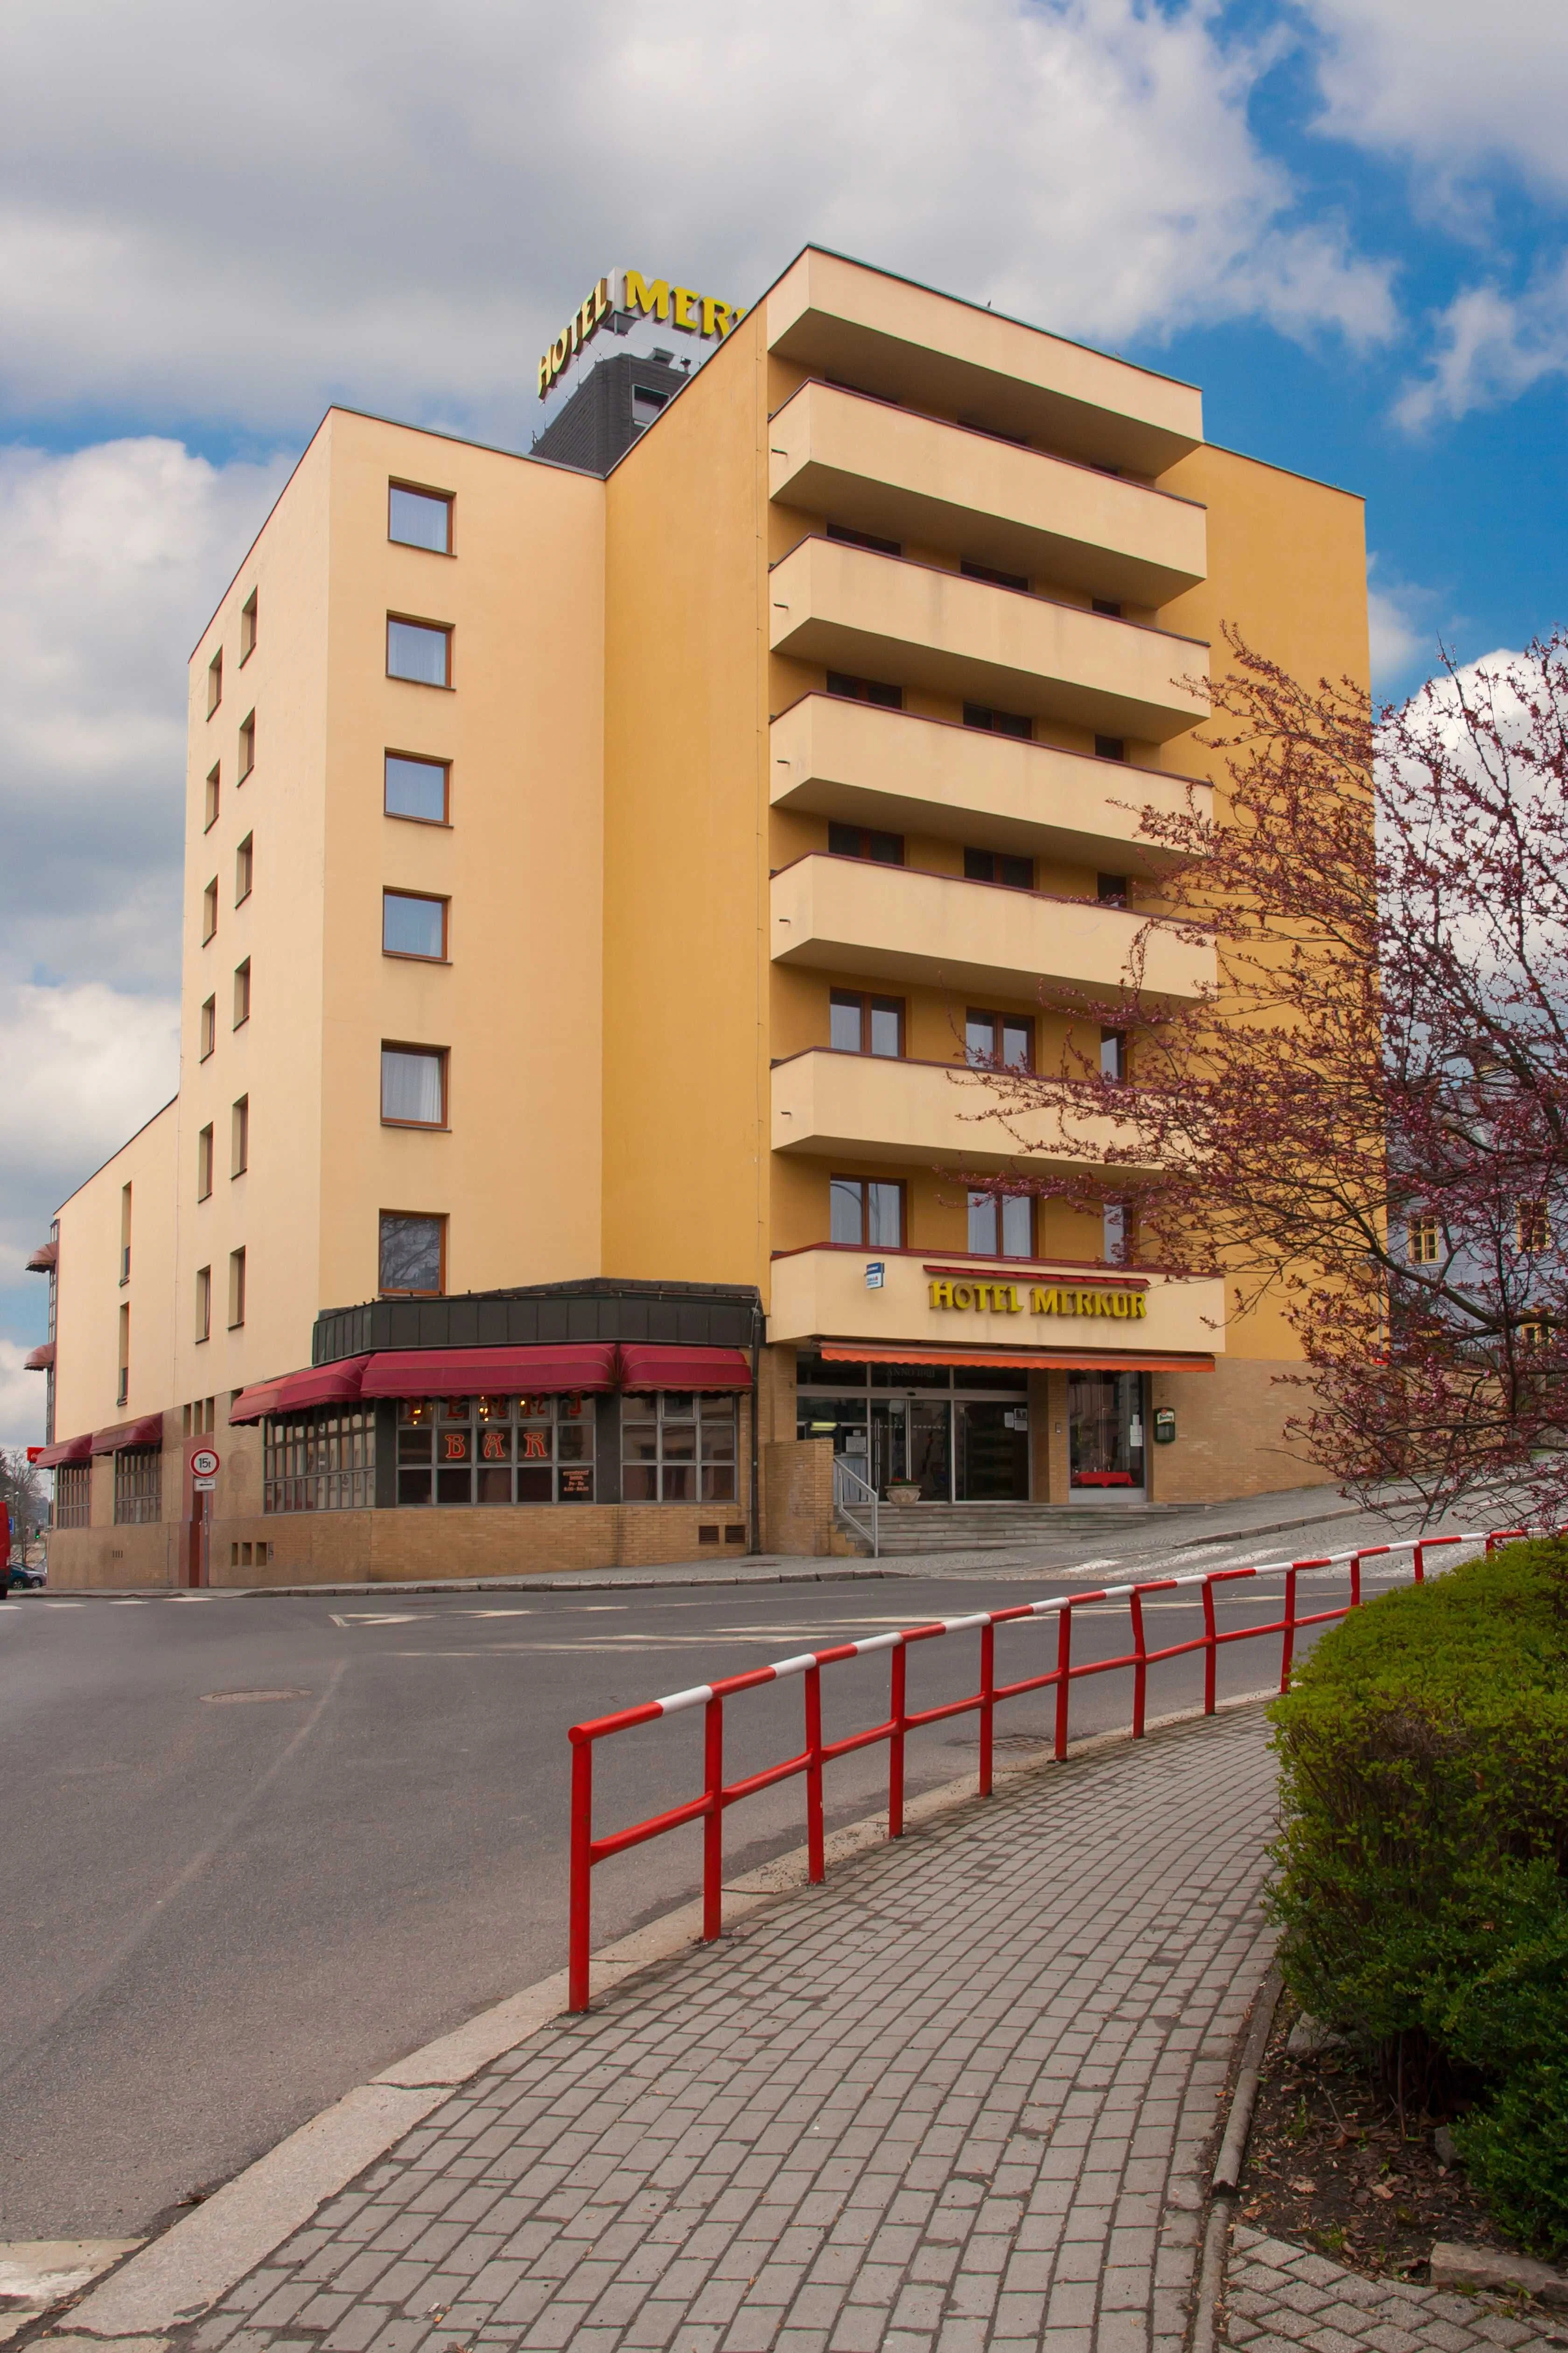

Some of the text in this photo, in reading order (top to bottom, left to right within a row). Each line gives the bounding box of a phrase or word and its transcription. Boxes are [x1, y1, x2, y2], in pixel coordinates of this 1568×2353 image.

[538, 270, 748, 400] HOTEL MER
[929, 1280, 1147, 1319] HOTEL MERKUR
[445, 1433, 547, 1459] BAR
[199, 1457, 211, 1468] 15t
